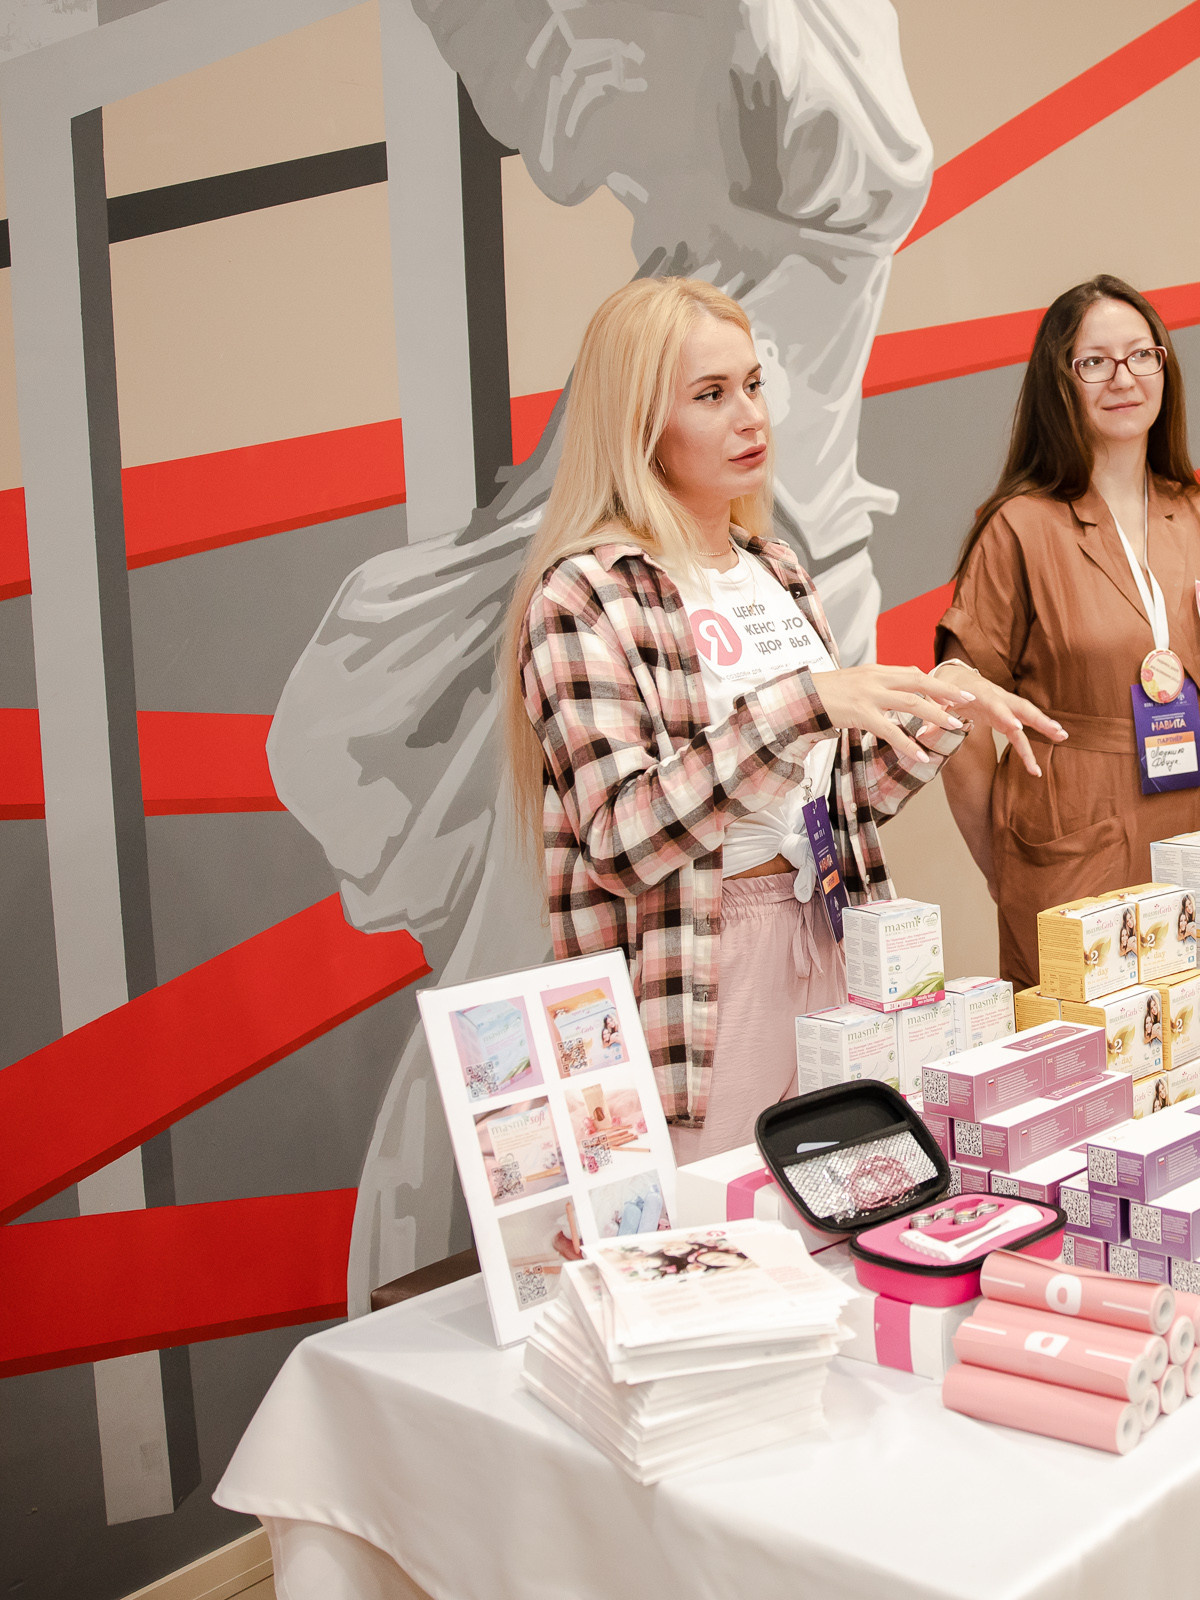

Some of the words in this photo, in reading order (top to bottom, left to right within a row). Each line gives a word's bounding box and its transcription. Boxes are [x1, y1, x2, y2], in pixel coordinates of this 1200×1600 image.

[732, 604, 766, 620] ЦЕНТР
[744, 617, 803, 636] ЖЕНСОГО
[754, 634, 812, 655] ДОРВЬЯ
[1151, 718, 1187, 731] НАВИТА
[884, 915, 921, 933] masmi
[1147, 933, 1155, 947] 2
[1091, 950, 1098, 964] 2
[969, 993, 998, 1011] masmi
[907, 1007, 938, 1025] masmi
[847, 1022, 880, 1042] masmi
[1176, 1018, 1183, 1032] 2
[1114, 1038, 1123, 1053] 2
